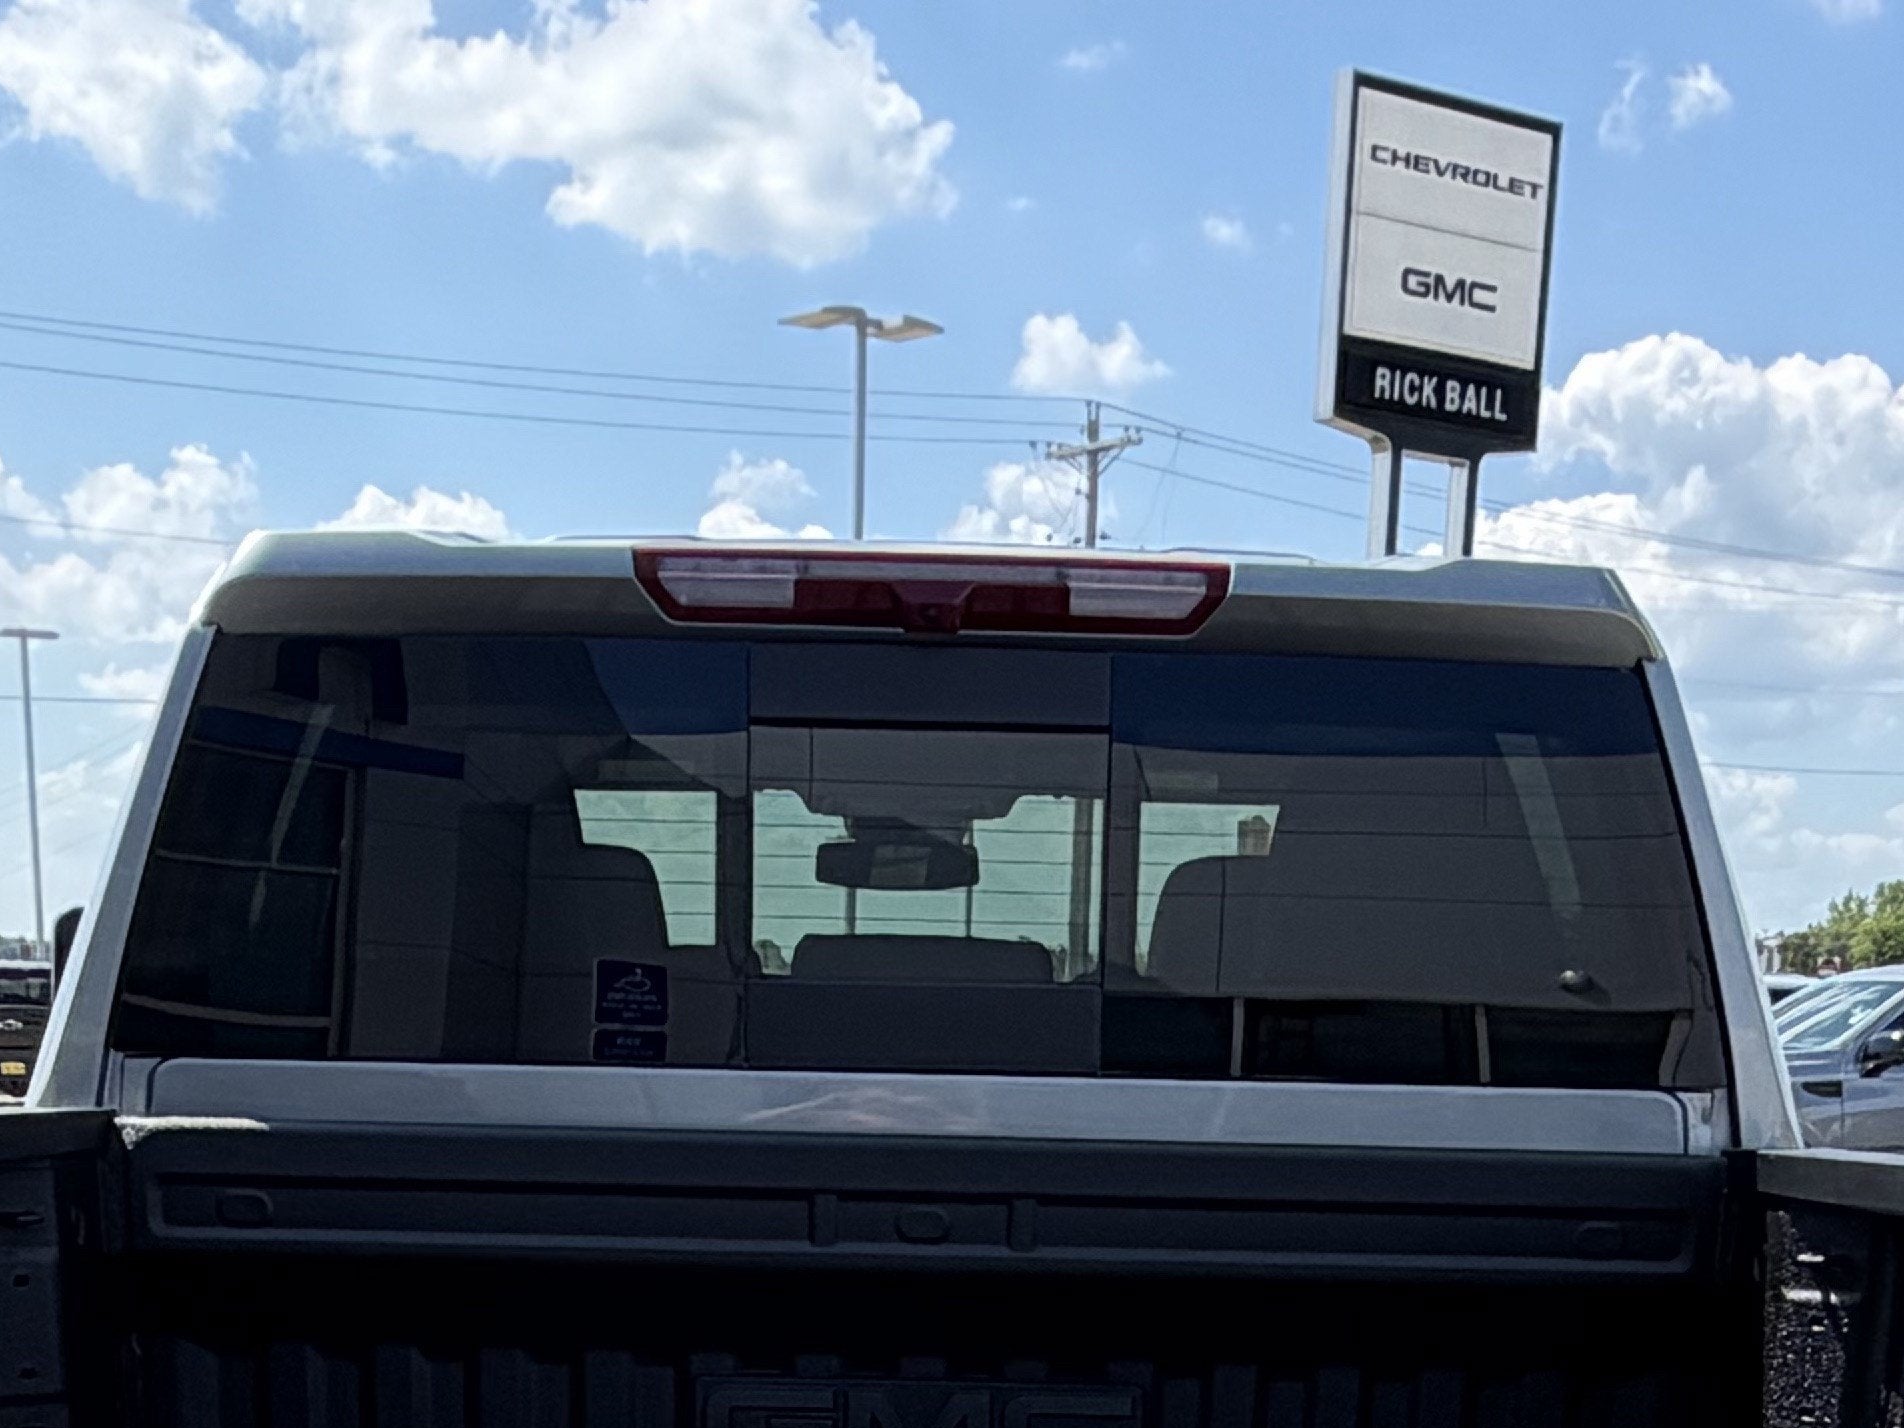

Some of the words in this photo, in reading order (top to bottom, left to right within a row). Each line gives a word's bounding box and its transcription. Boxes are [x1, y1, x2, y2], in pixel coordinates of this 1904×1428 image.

[1370, 143, 1544, 200] CHEVROLET
[1400, 266, 1498, 313] GMC
[1373, 365, 1440, 410] RICK
[1444, 377, 1508, 421] BALL
